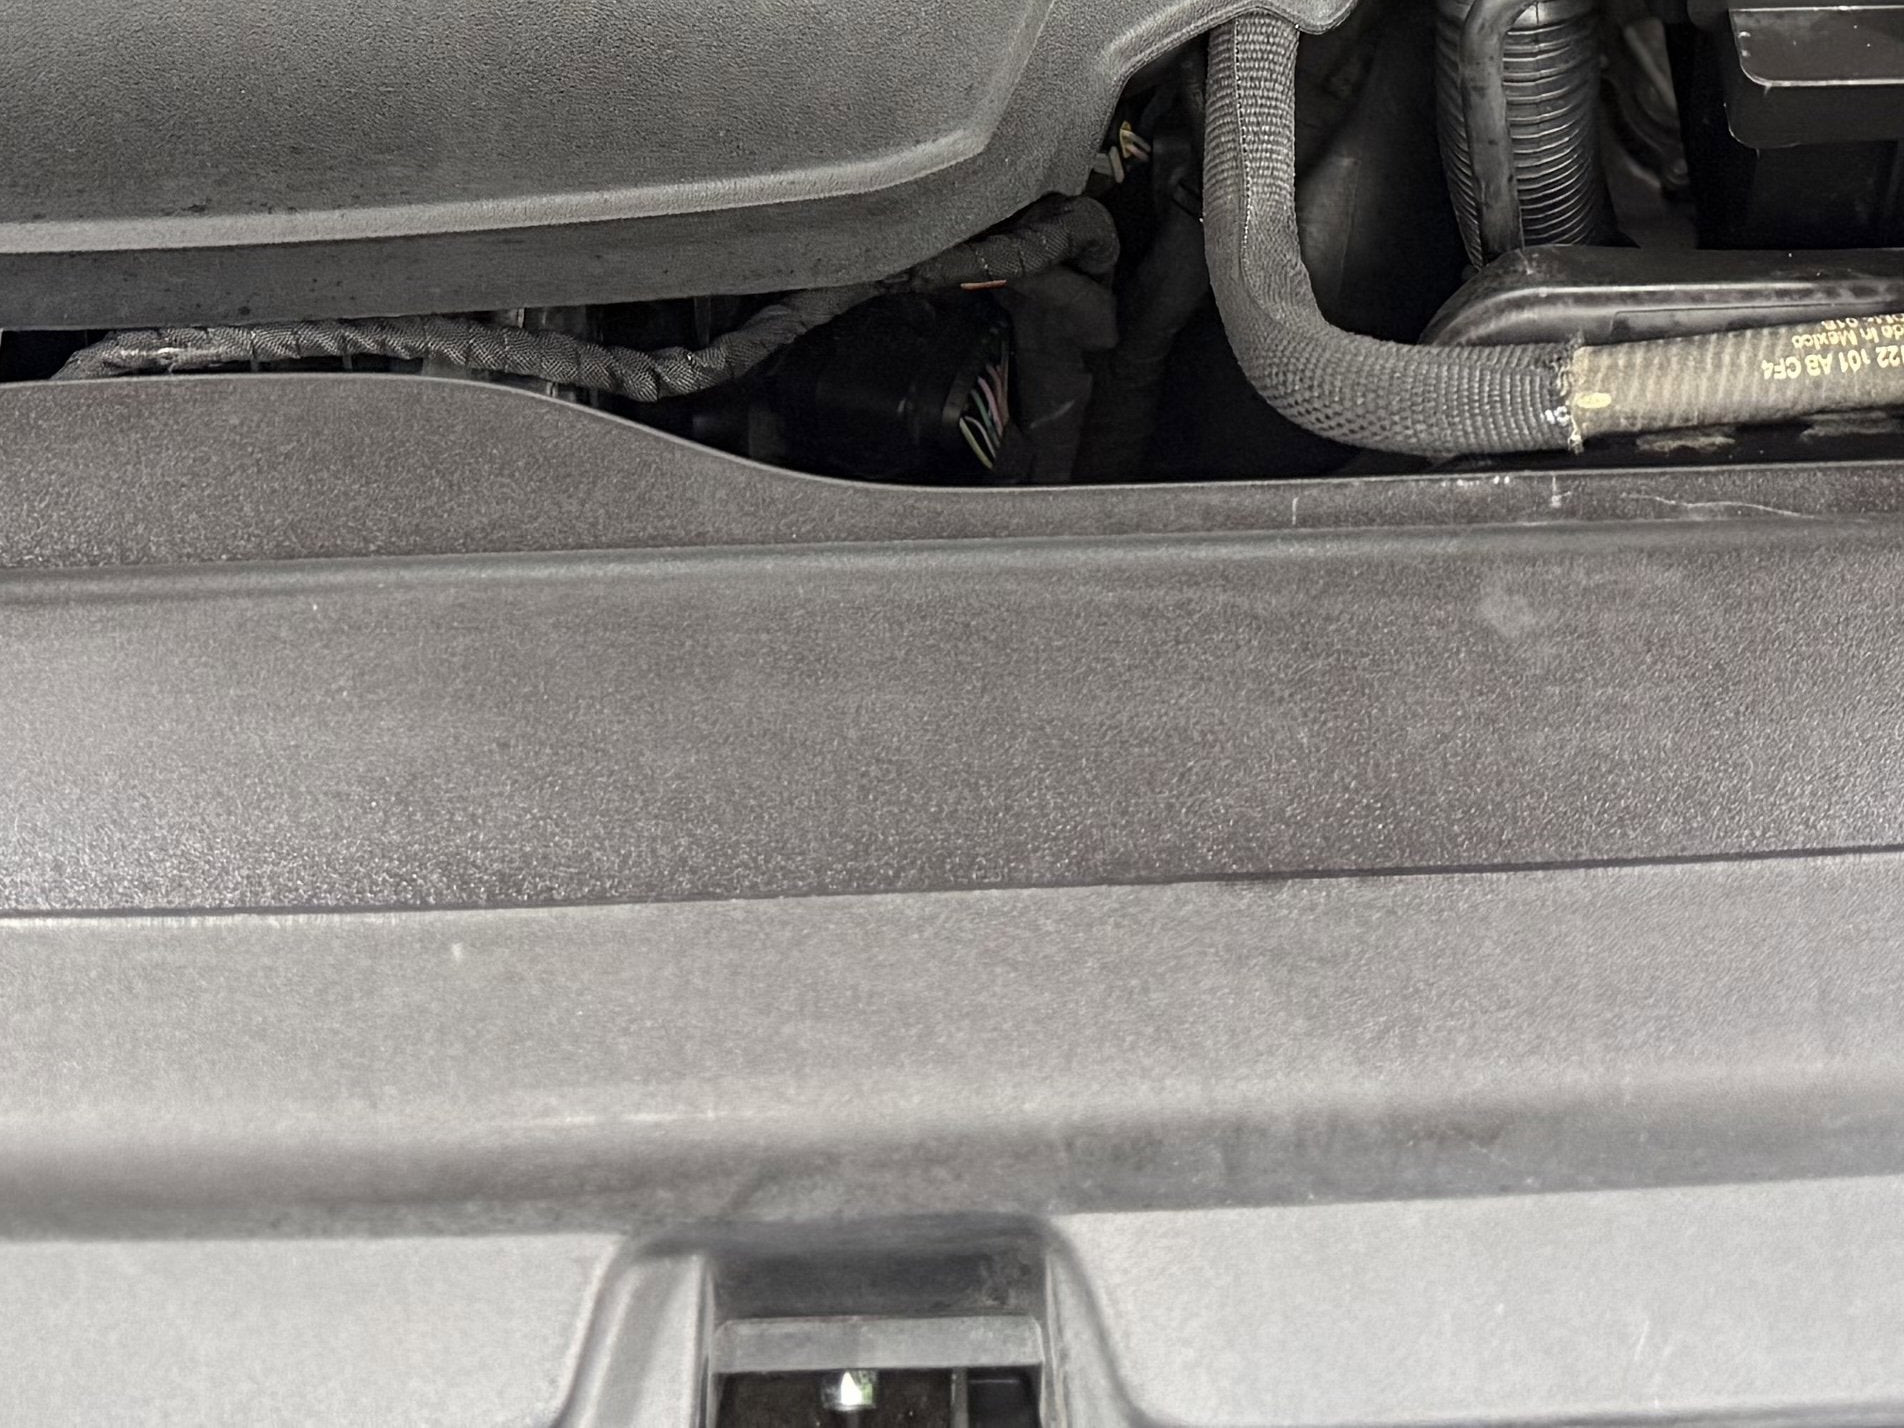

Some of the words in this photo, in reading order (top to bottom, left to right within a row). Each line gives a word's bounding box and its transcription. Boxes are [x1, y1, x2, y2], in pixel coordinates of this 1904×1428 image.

[1792, 329, 1858, 350] Mexico
[1859, 326, 1879, 345] in
[1760, 356, 1802, 381] CF4
[1805, 353, 1833, 377] AB
[1838, 349, 1870, 375] 101
